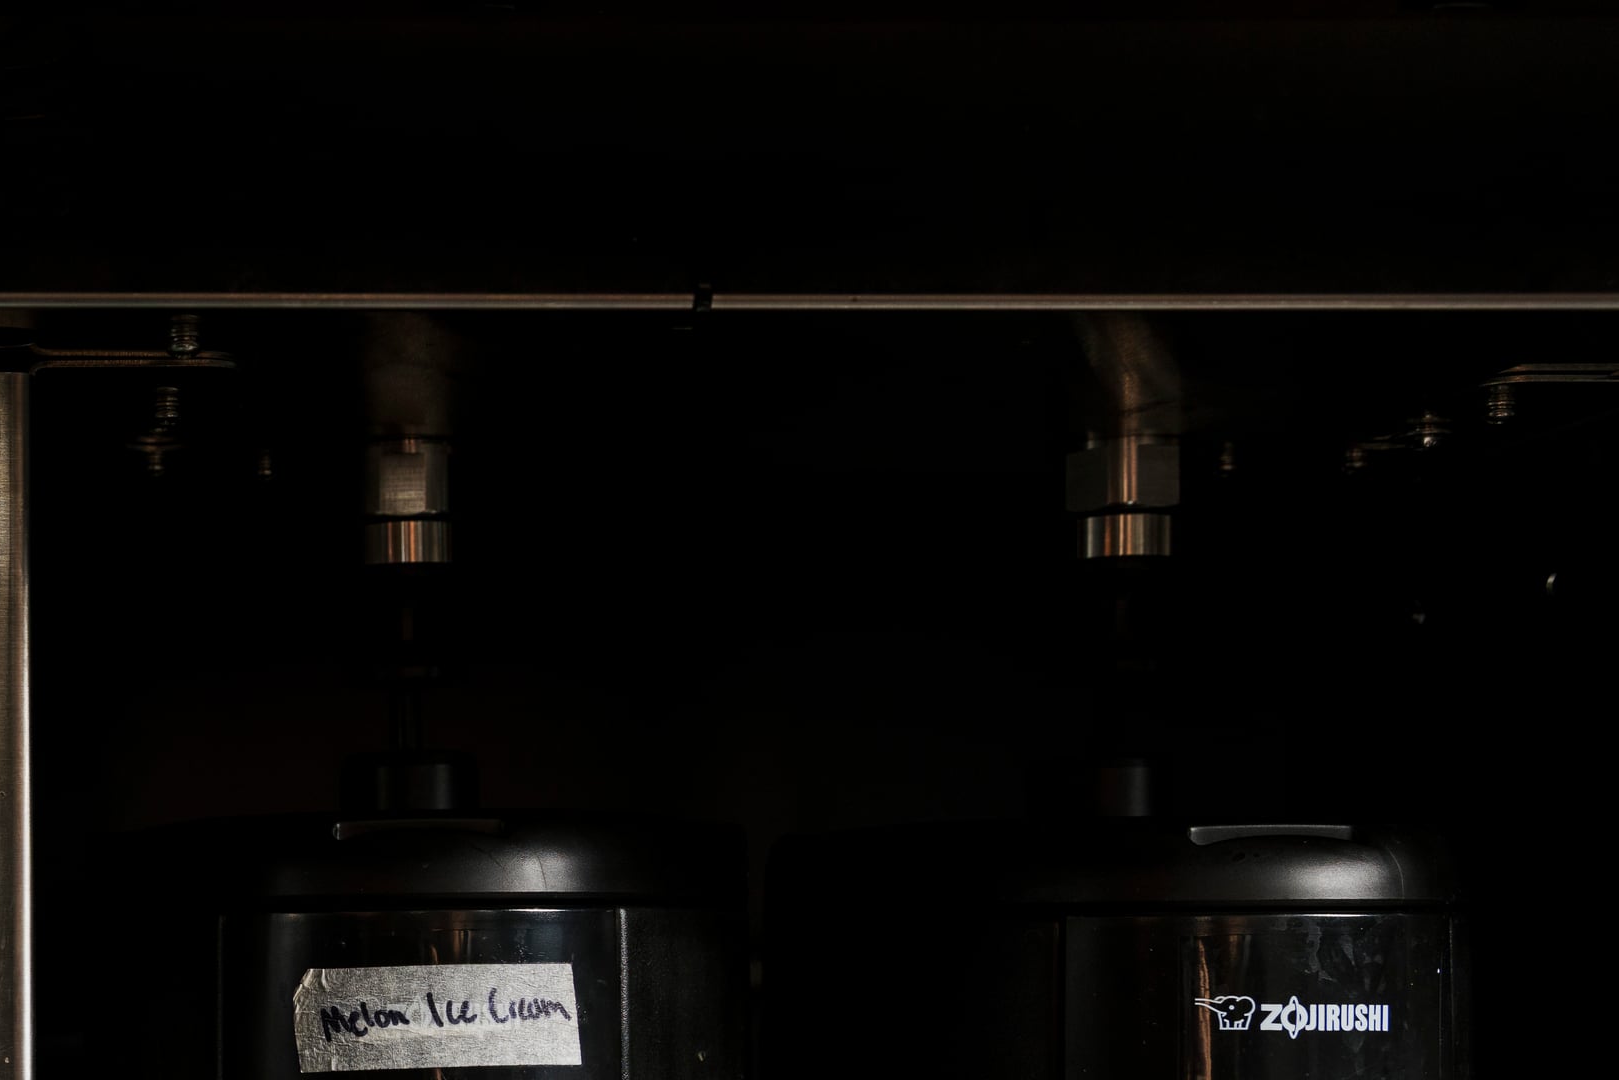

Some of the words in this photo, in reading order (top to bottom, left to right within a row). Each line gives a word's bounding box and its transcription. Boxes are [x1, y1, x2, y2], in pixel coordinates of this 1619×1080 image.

[320, 1001, 411, 1042] Melon
[426, 992, 478, 1028] Ice
[488, 987, 572, 1024] Cream
[1259, 995, 1389, 1040] ZOJIRUSHI
